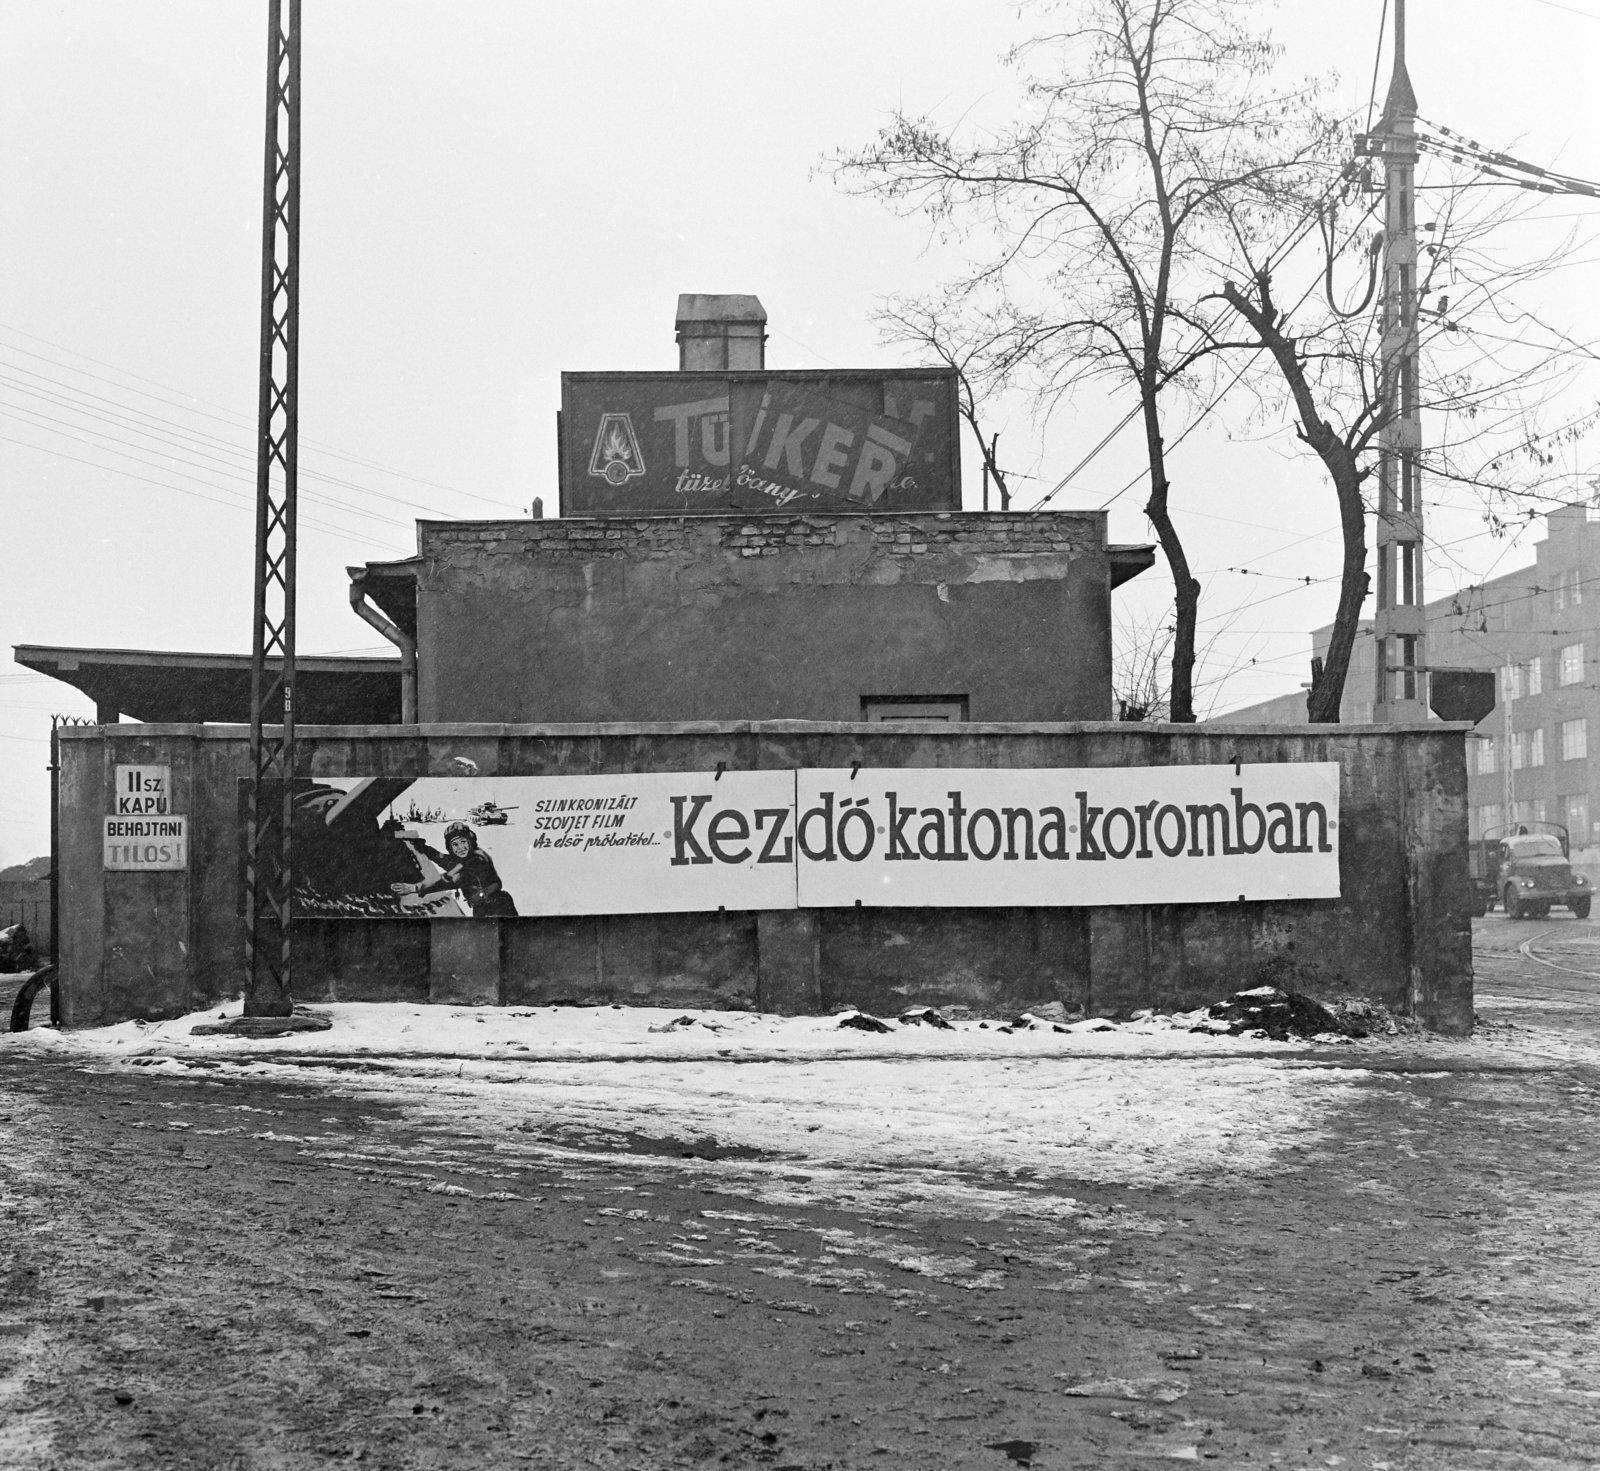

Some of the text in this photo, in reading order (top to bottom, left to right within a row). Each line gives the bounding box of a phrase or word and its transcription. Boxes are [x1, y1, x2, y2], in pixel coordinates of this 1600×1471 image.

[119, 797, 167, 814] KAPU
[534, 794, 638, 813] SZINKRONIZÁLT
[107, 822, 182, 836] BEHAJTANI
[534, 814, 625, 833] SZOVJET FILM
[669, 787, 1333, 866] Kezdő katona koromban
[533, 832, 552, 849] Az
